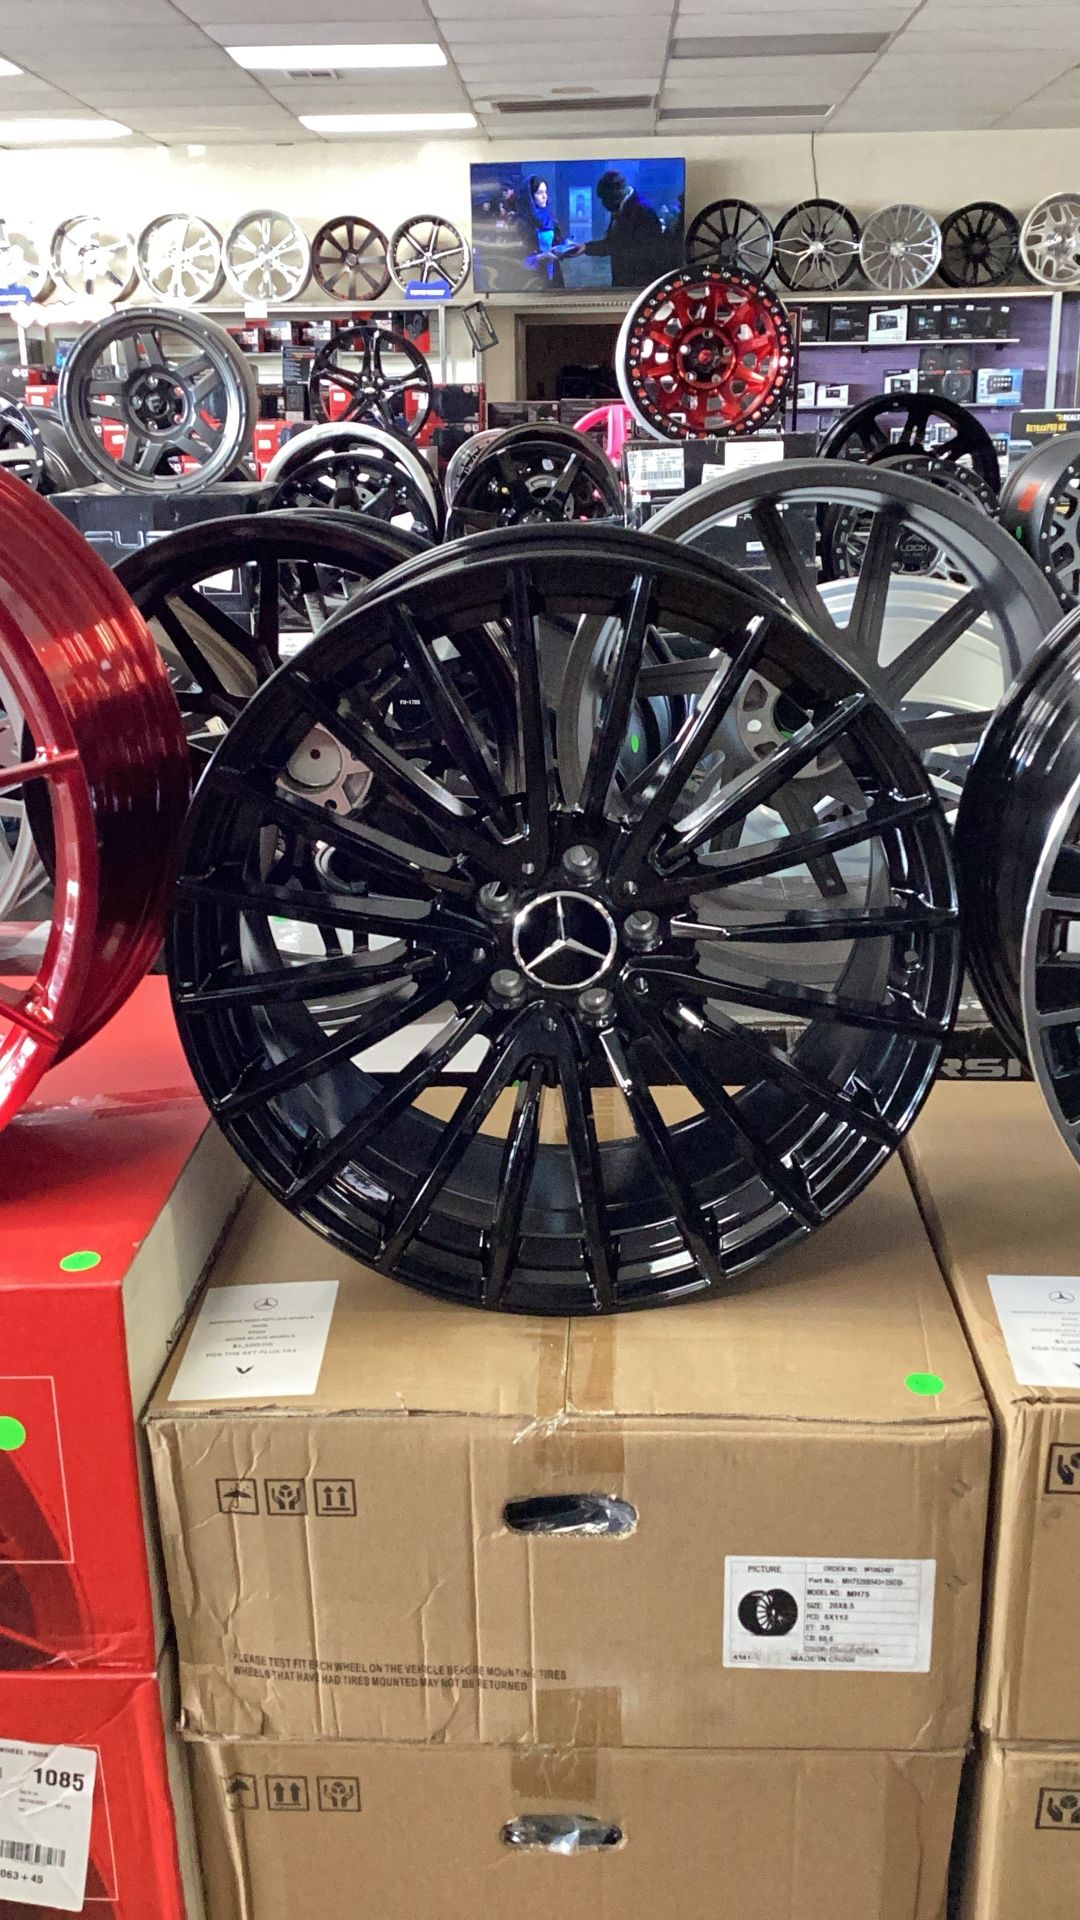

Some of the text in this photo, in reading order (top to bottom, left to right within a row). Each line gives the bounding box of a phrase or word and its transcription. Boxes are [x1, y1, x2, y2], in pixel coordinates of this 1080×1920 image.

[747, 1565, 782, 1573] PICTURE
[233, 1653, 267, 1666] PLEASE
[268, 1656, 291, 1668] TEST
[293, 1658, 307, 1669] FIT
[334, 1661, 368, 1673] WHEEL
[369, 1663, 383, 1673] ON
[385, 1663, 403, 1674] THE
[404, 1664, 444, 1676] VEHICLE
[447, 1664, 484, 1676] BEFORE
[486, 1666, 537, 1678] MOUNTIN
[539, 1668, 567, 1680] TIRES
[233, 1665, 527, 1691] WHEELS THAT HAVE HAD TIRES MOUNTED MAY NOT BE RETURNED
[33, 1767, 85, 1792] 1085
[30, 1874, 44, 1885] 45
